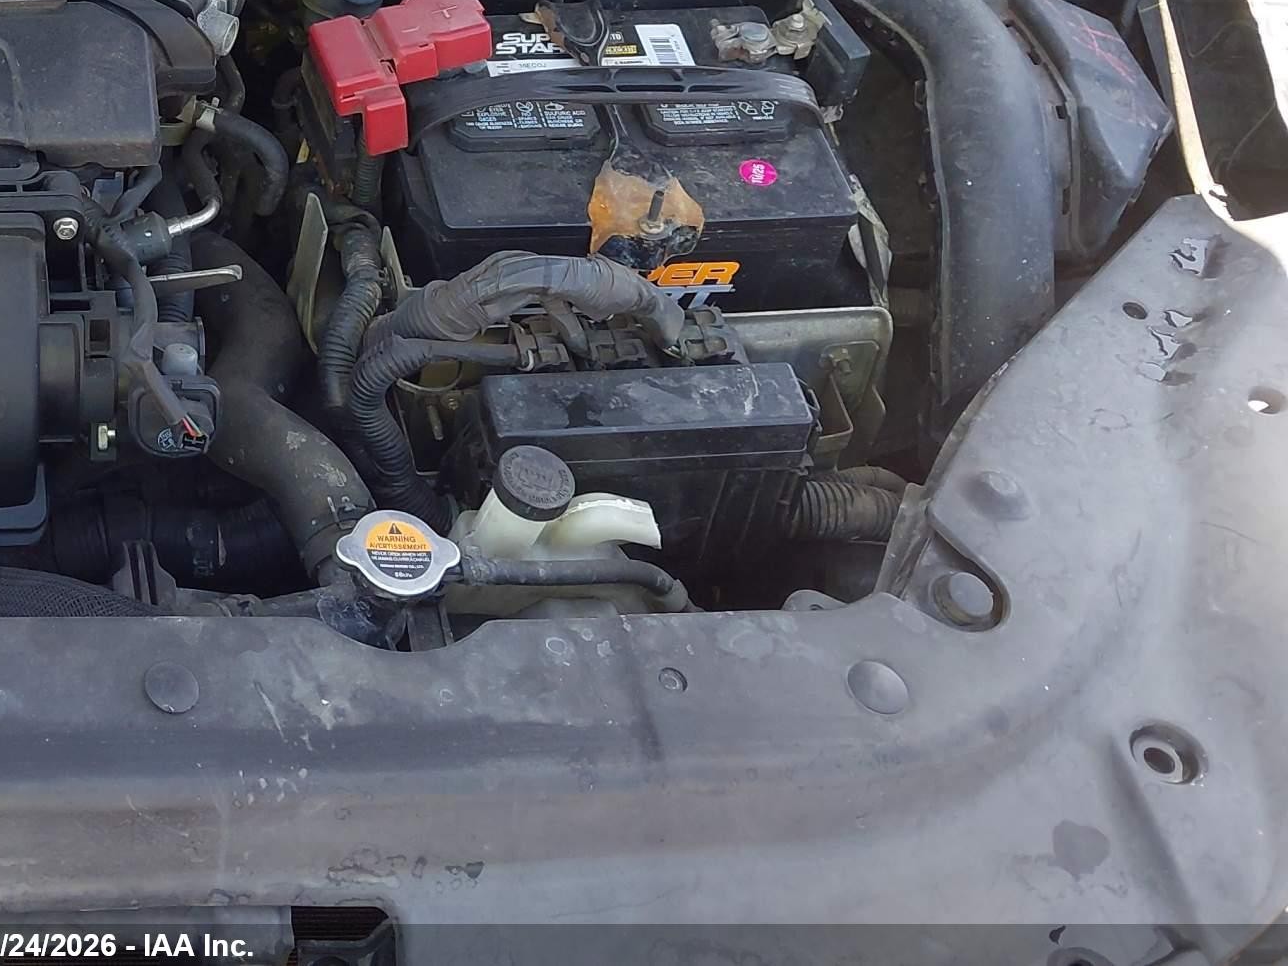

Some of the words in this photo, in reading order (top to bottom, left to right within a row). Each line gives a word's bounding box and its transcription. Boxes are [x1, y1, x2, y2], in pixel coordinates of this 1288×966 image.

[502, 32, 551, 45] SUP
[495, 42, 566, 55] STAR
[376, 535, 417, 543] WARNING
[369, 542, 427, 550] AVERTISSEMENT
